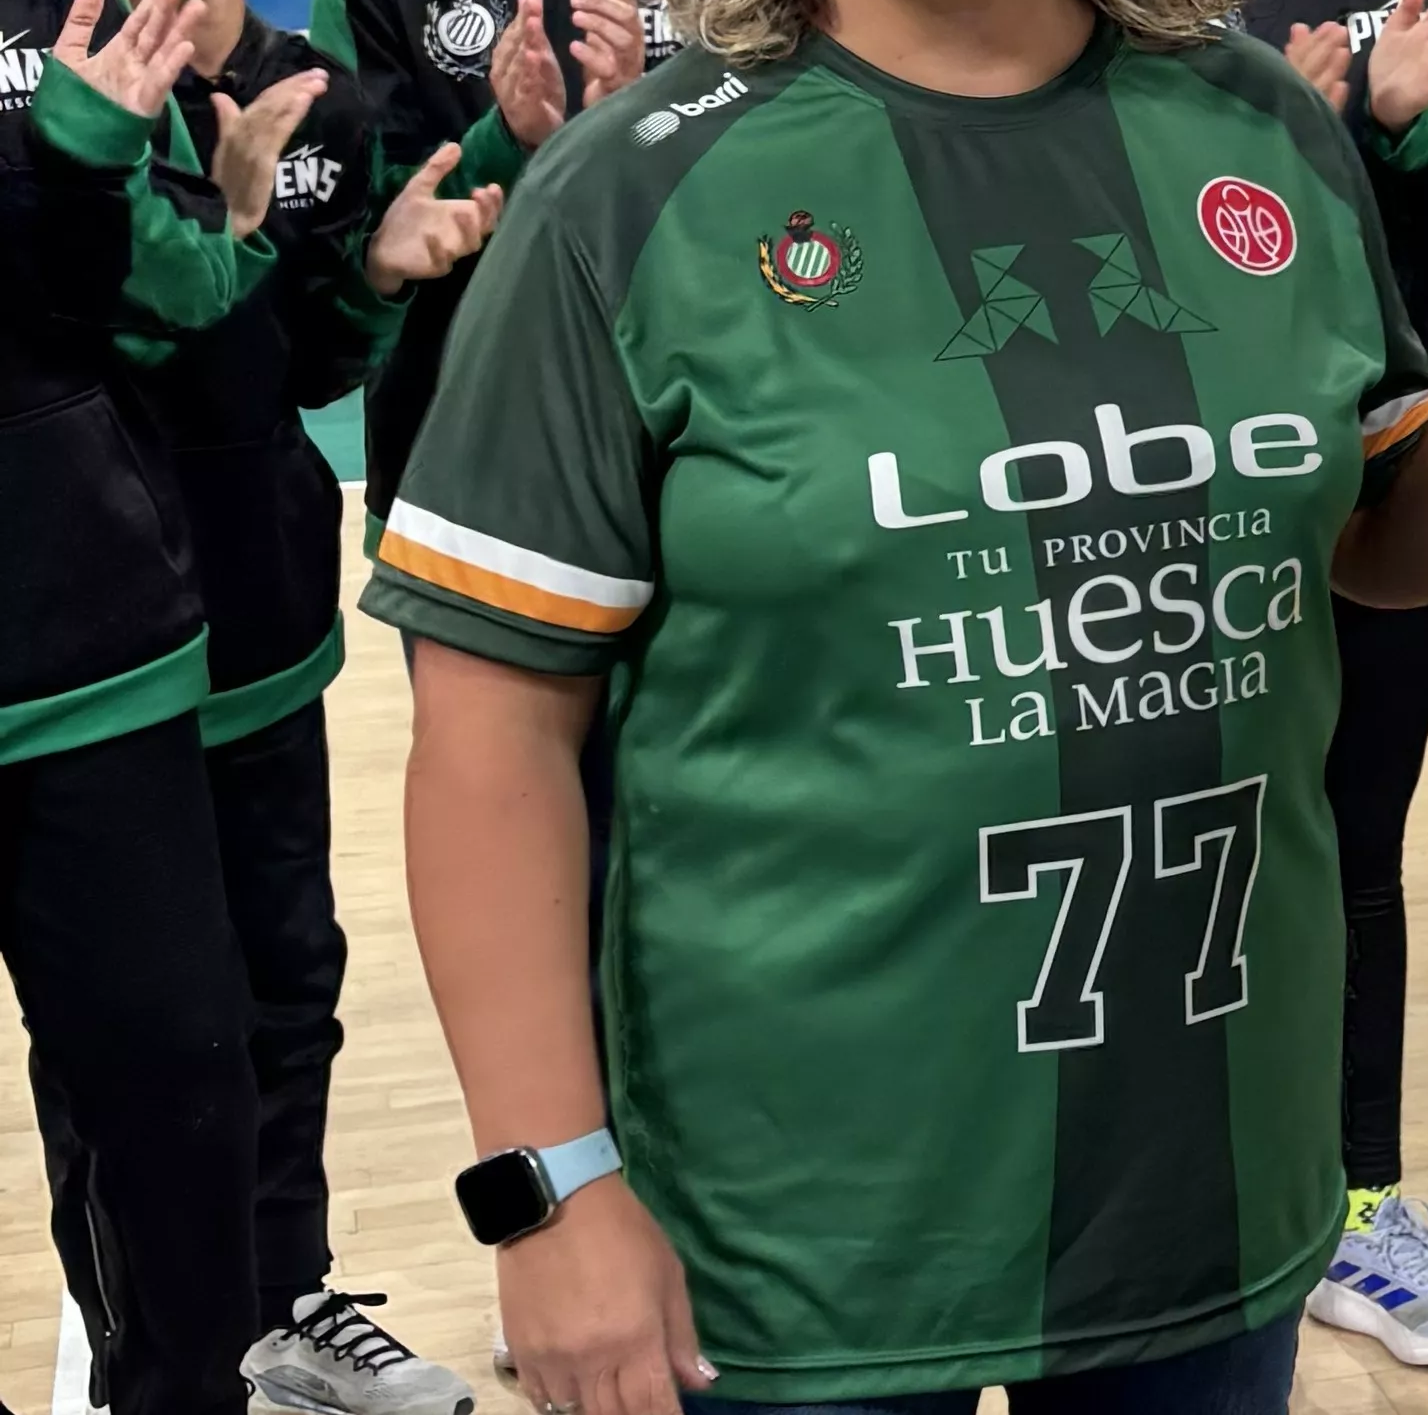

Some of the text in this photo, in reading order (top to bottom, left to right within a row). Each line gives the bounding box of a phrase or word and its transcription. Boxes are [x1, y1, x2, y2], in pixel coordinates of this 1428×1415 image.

[867, 403, 1324, 530] Lobe
[887, 556, 1304, 689] Huesca
[947, 545, 1013, 580] Tu
[965, 690, 1056, 747] La
[978, 773, 1268, 1054] 77
